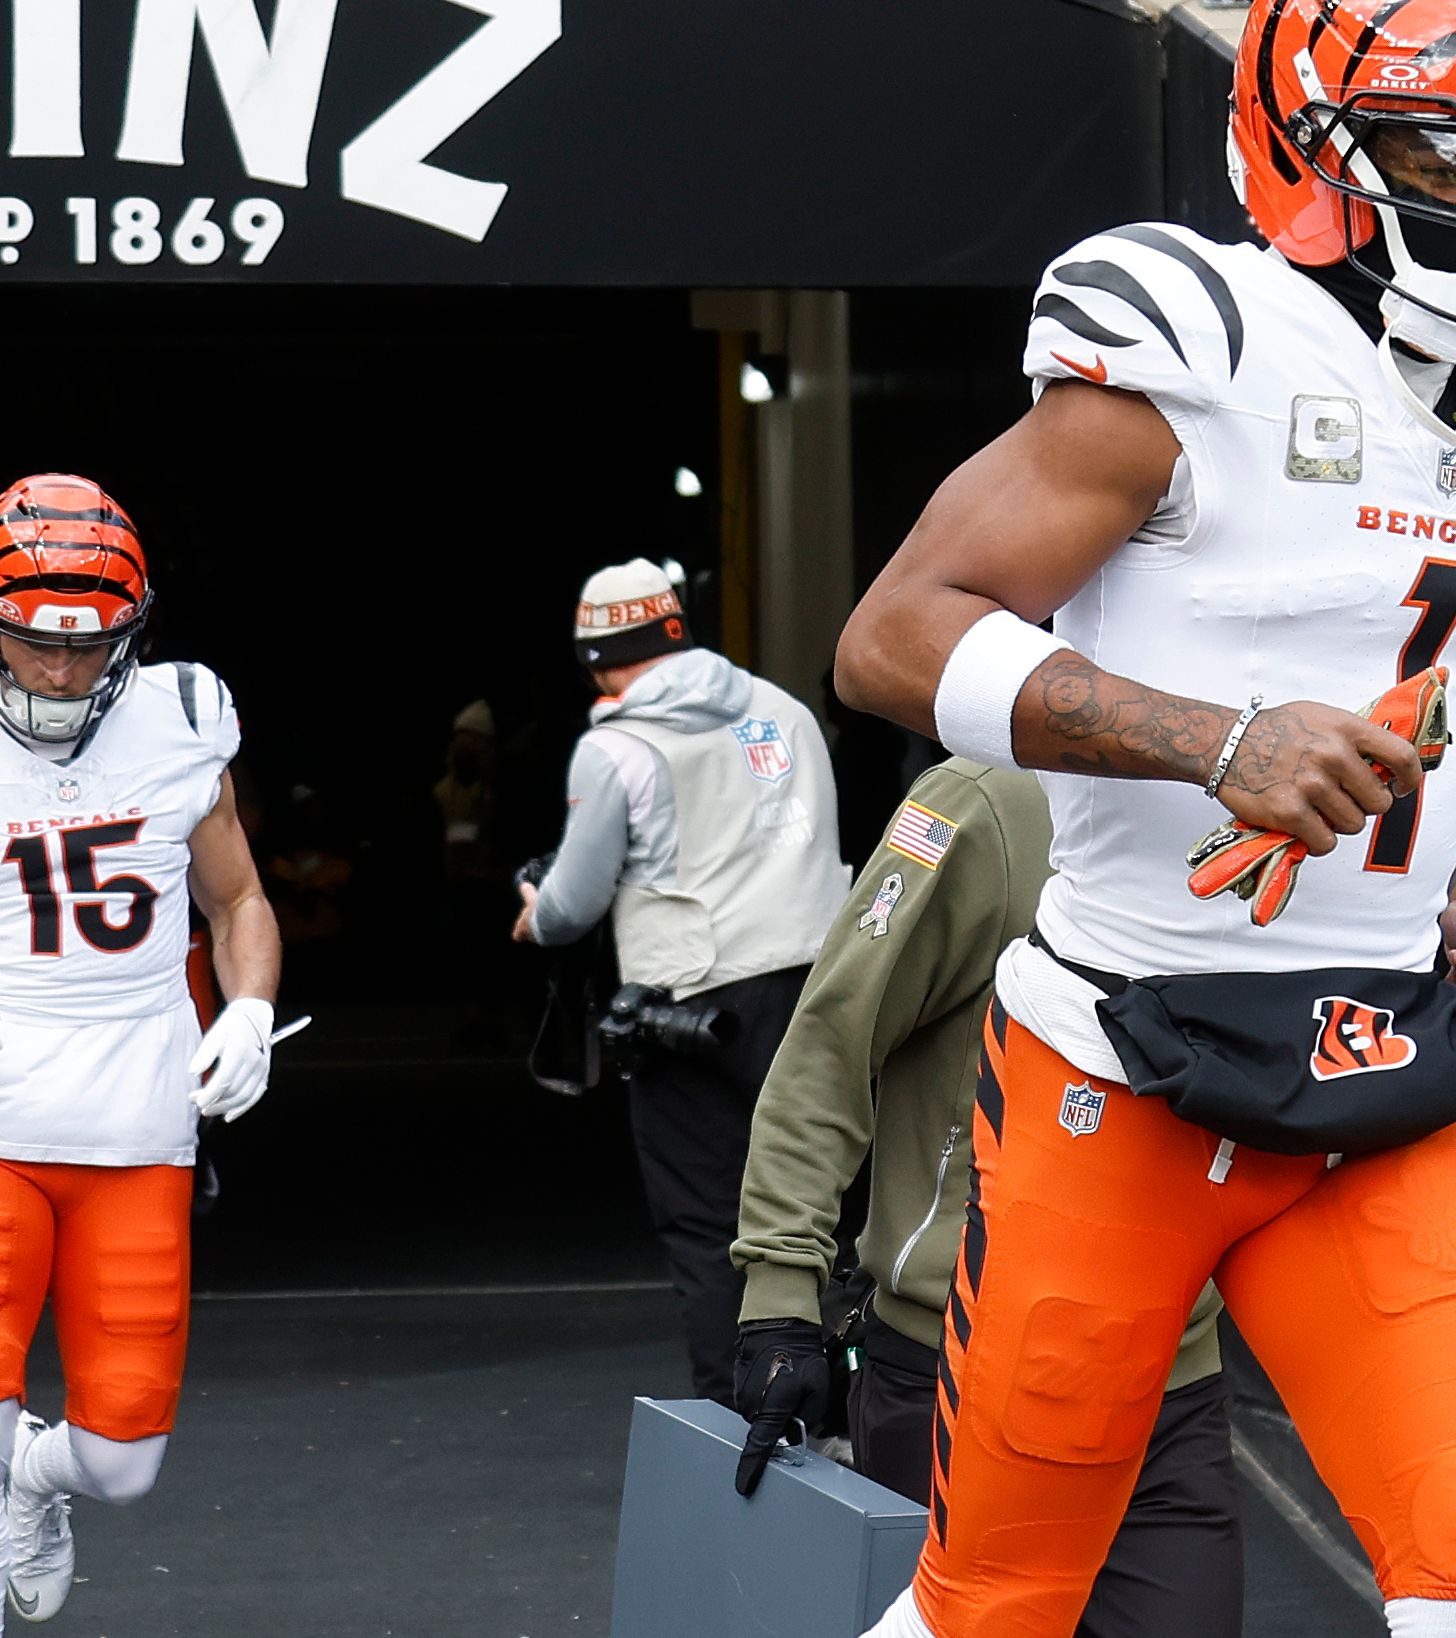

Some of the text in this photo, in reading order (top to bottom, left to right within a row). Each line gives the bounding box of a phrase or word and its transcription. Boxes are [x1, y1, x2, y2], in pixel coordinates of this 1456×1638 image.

[1371, 79, 1427, 90] OAKLEY
[66, 197, 284, 265] 1869
[1295, 400, 1359, 459] C
[746, 742, 789, 777] NFL
[1, 816, 161, 957] 15
[1065, 1104, 1094, 1127] NFL
